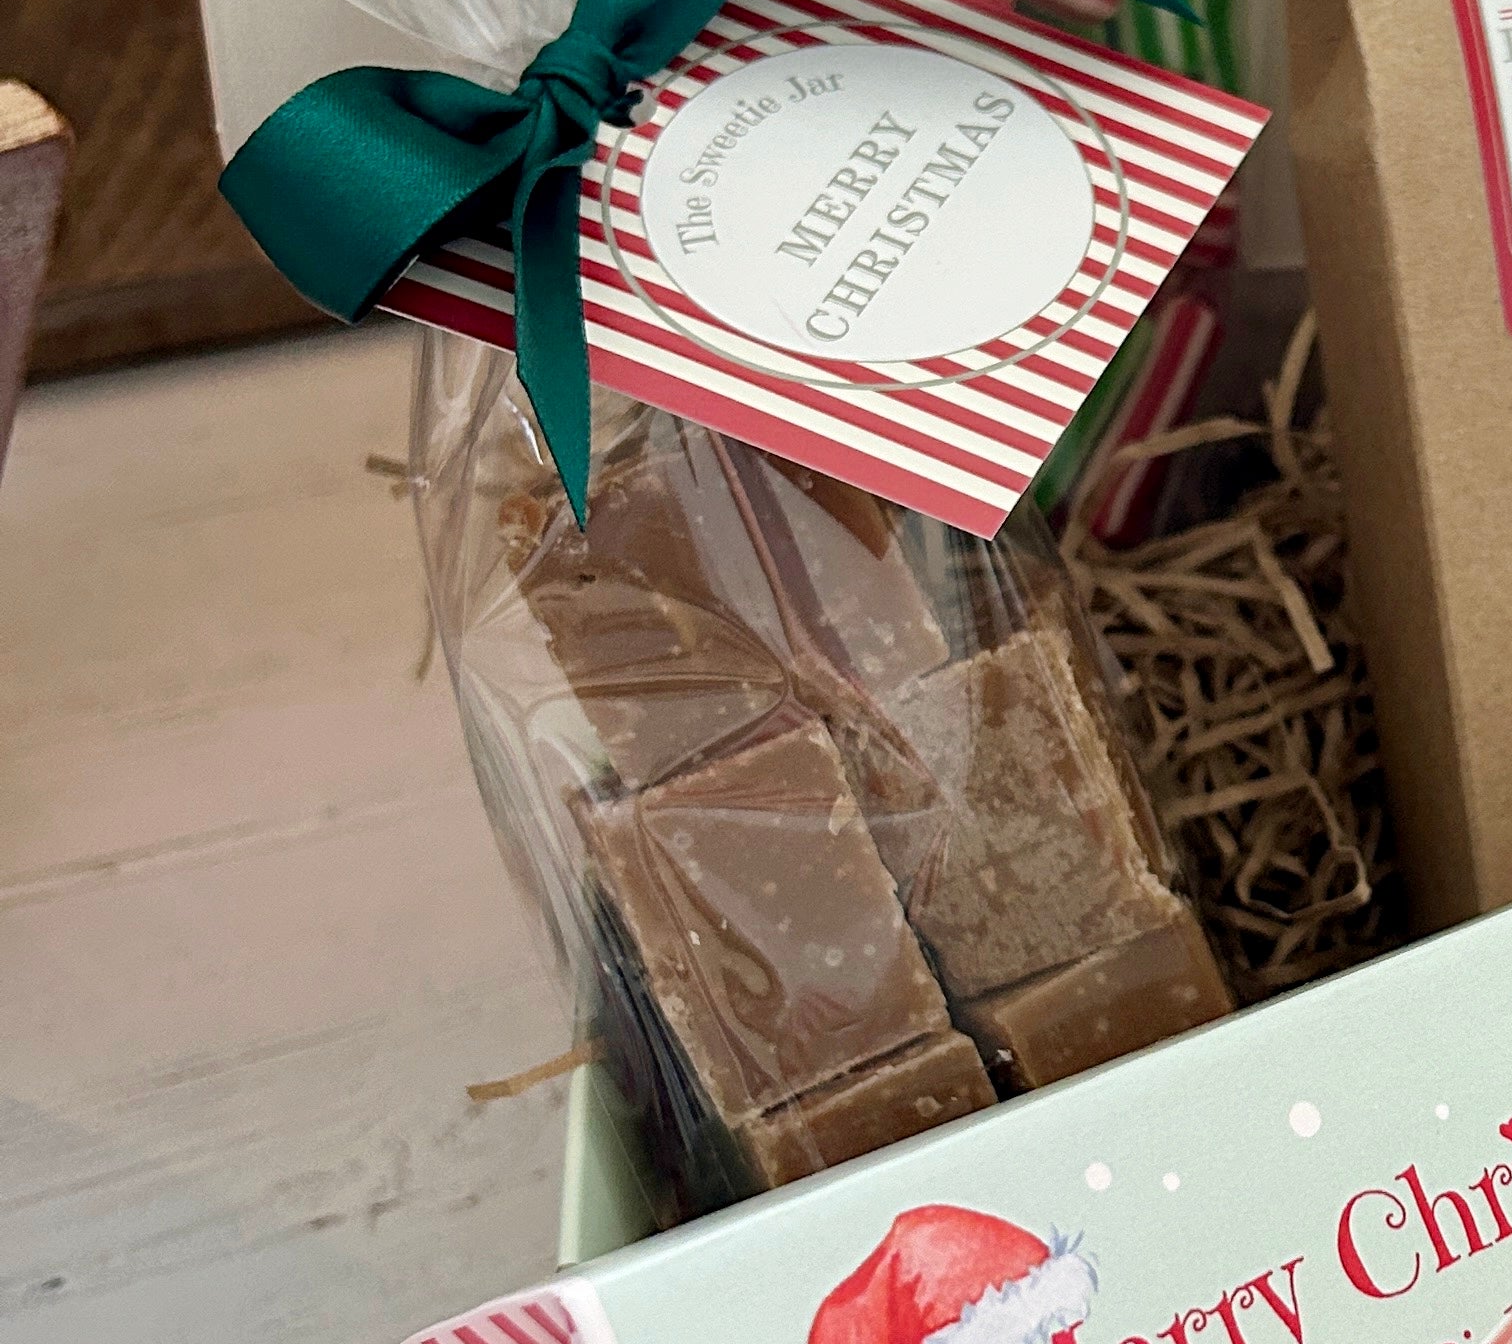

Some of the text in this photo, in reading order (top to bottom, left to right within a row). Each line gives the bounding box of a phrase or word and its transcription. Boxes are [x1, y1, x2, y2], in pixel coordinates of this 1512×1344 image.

[676, 70, 846, 255] The Sweetie Jar
[775, 110, 919, 268] MERRY
[804, 91, 1017, 343] CHRISTMAS
